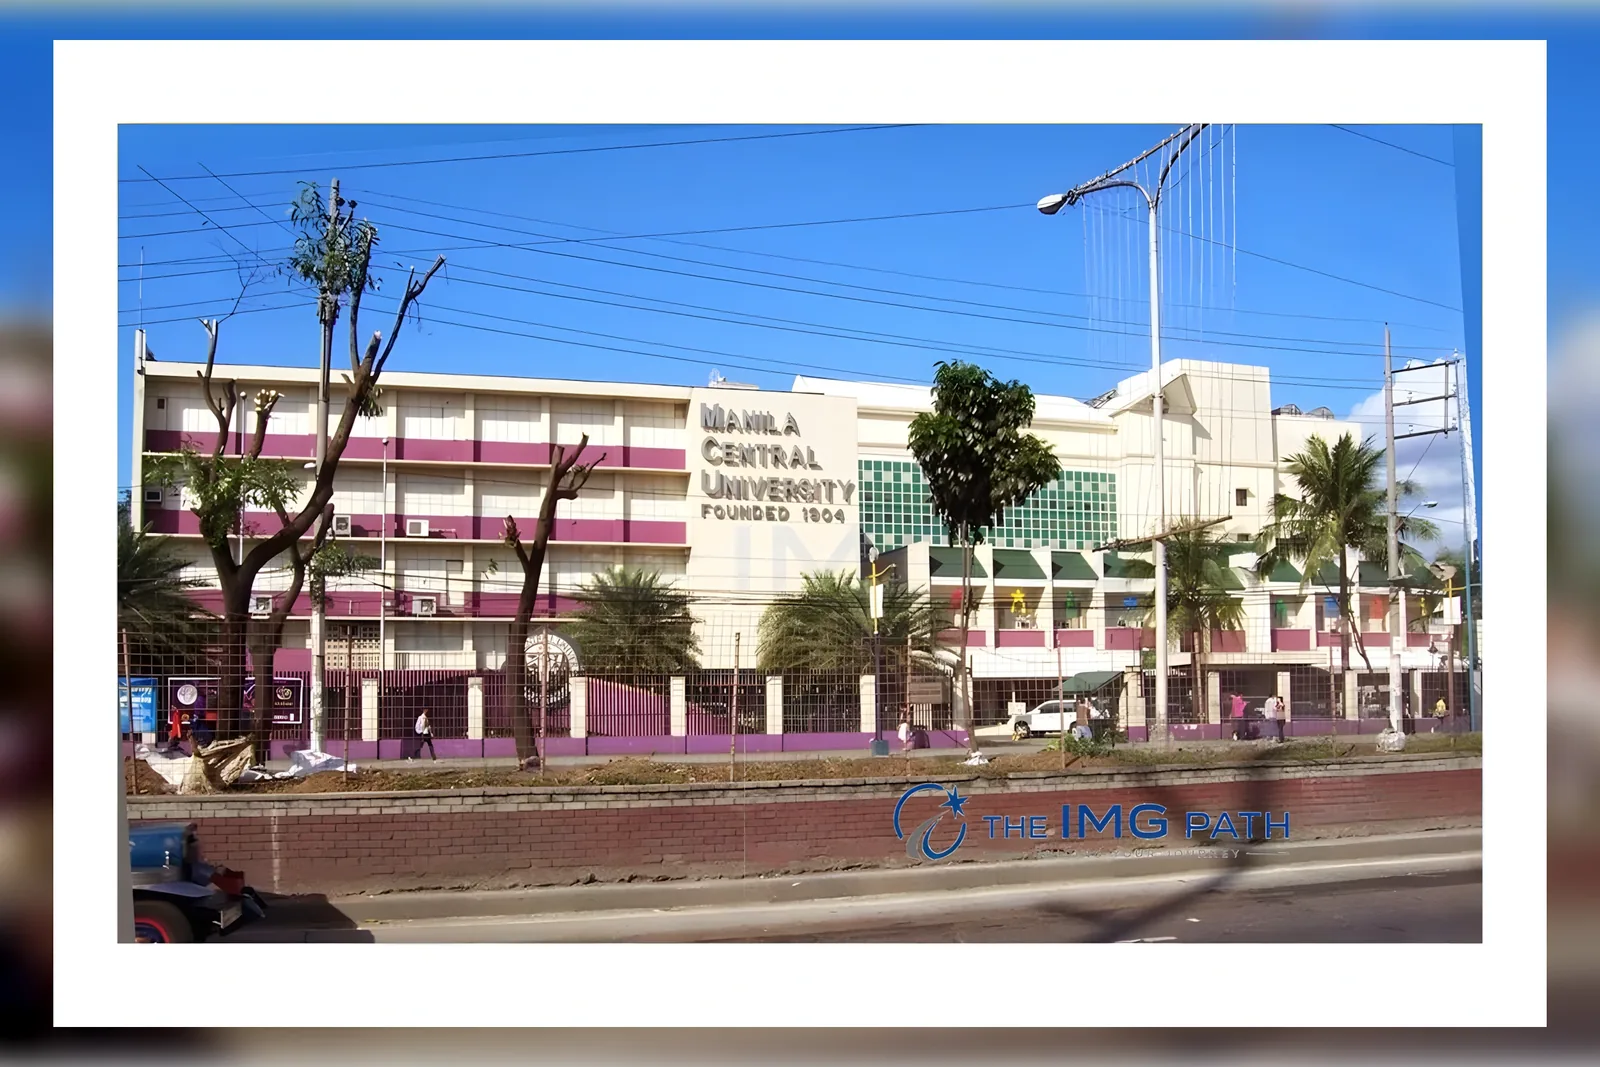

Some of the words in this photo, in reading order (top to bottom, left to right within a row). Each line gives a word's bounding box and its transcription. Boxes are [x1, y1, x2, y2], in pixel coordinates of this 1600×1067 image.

[700, 403, 801, 437] MANILA
[701, 435, 823, 470] CENTRAL
[701, 469, 856, 505] UNIVERSITY
[701, 503, 790, 522] FOUNDED
[802, 506, 846, 524] 1904
